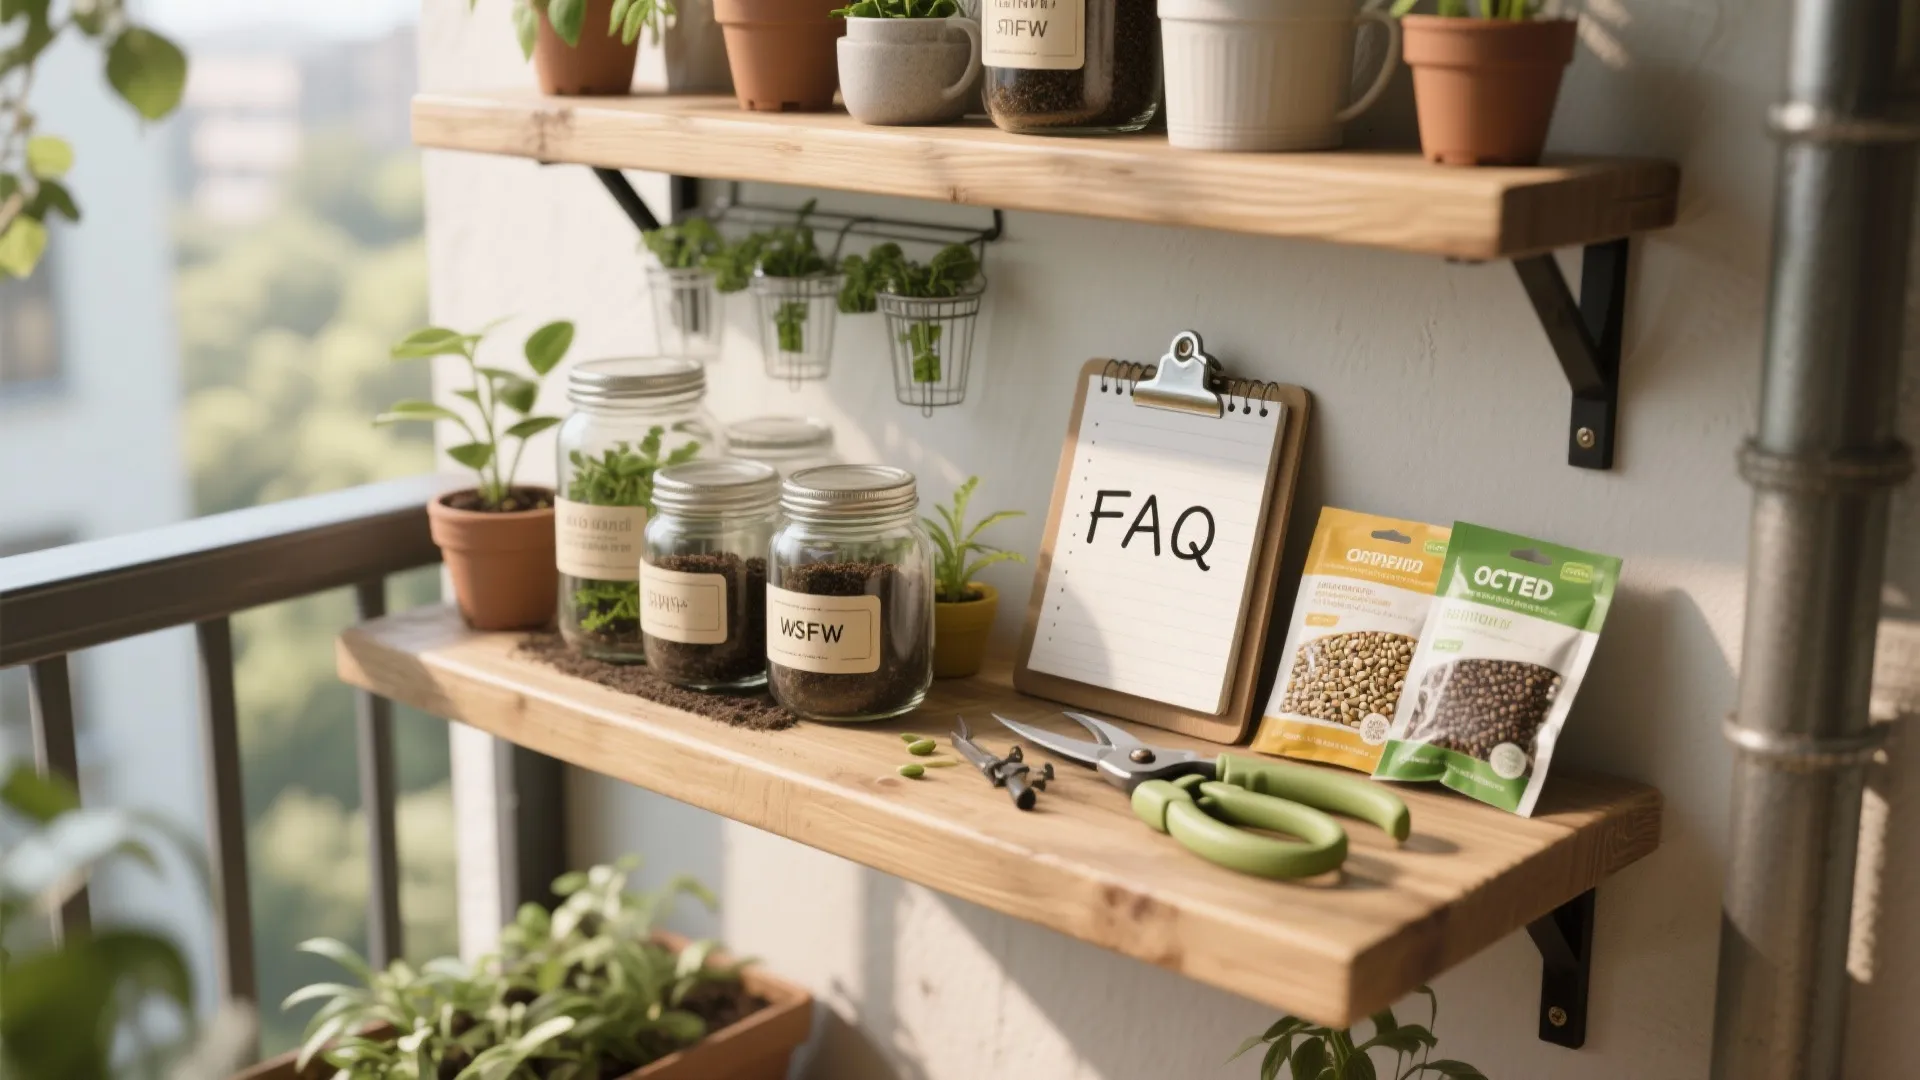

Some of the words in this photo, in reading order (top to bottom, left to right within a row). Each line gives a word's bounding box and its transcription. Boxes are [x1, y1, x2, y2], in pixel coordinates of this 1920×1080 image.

[1087, 490, 1215, 571] FAQ
[1474, 566, 1554, 601] OCTED
[780, 616, 844, 643] WSFW
